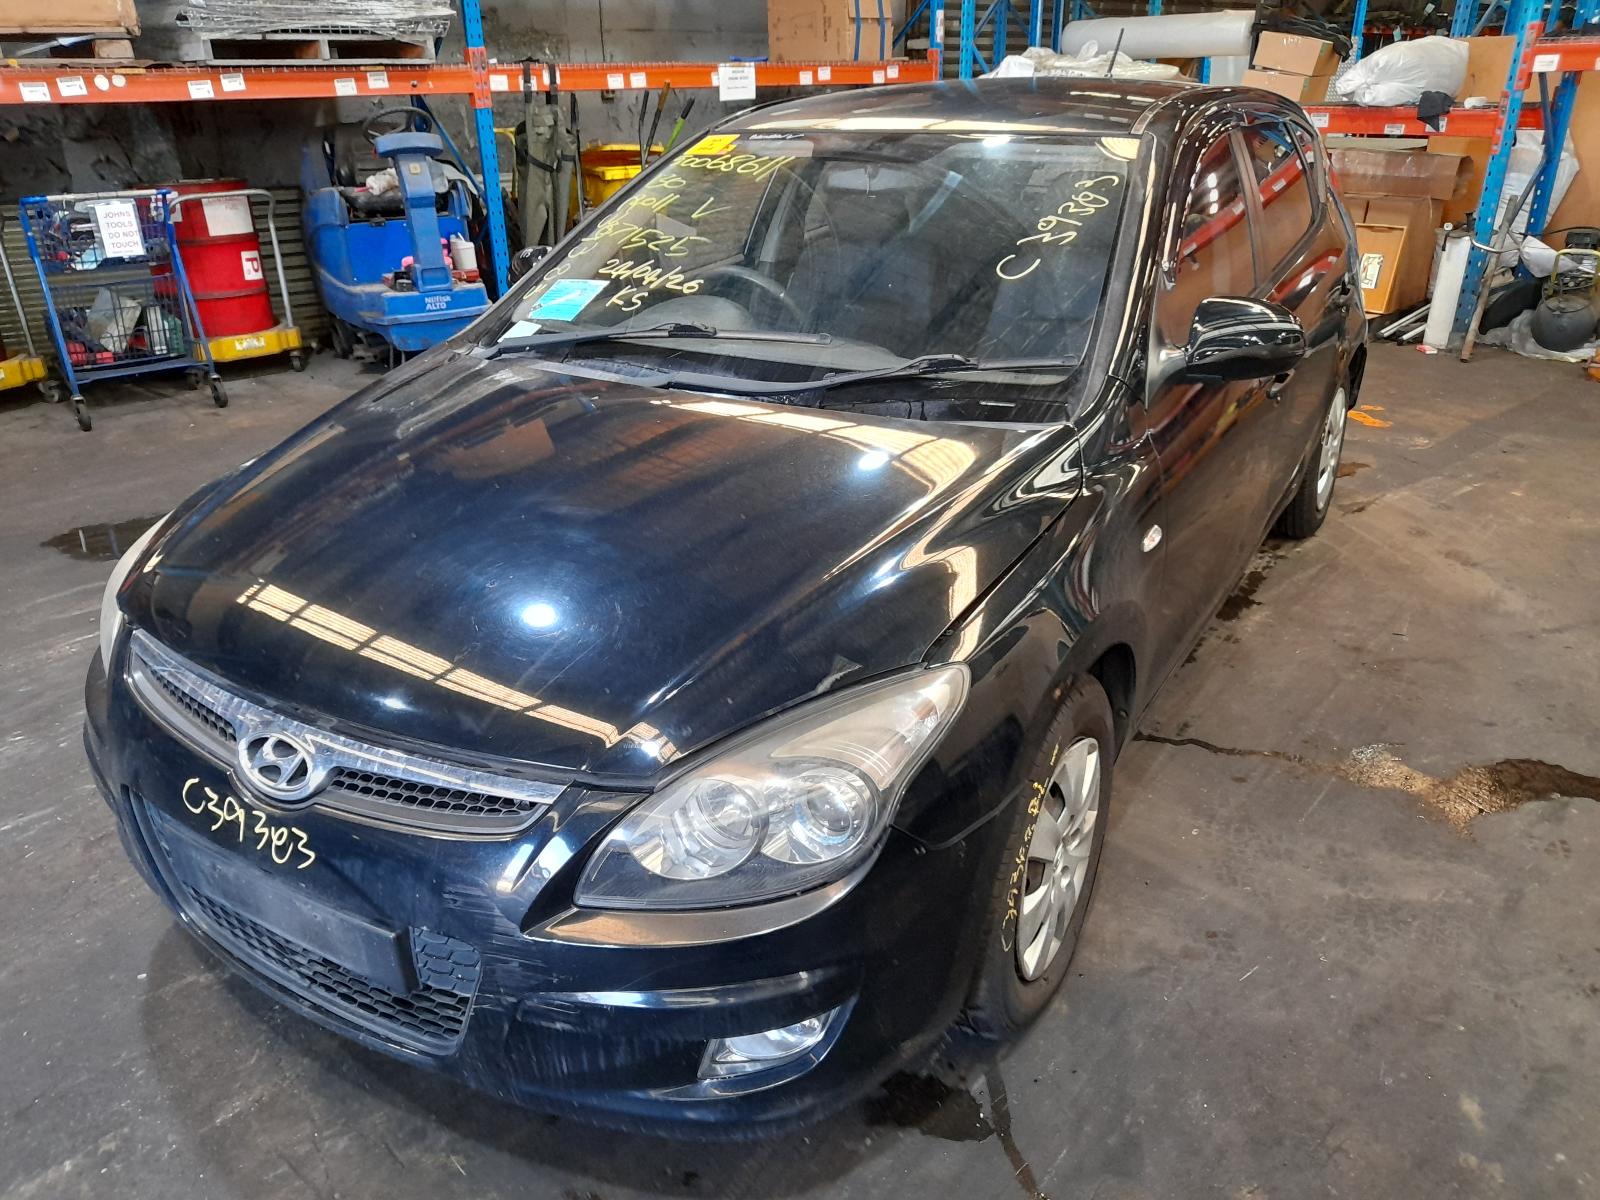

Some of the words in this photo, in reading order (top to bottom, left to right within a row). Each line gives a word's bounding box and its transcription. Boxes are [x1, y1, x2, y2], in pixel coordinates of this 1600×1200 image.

[105, 220, 133, 229] TOOLS
[122, 230, 139, 238] NOT
[111, 240, 139, 249] TOUCH
[598, 258, 705, 294] 24/04/26
[605, 284, 649, 311] KS
[425, 302, 447, 311] ALTO
